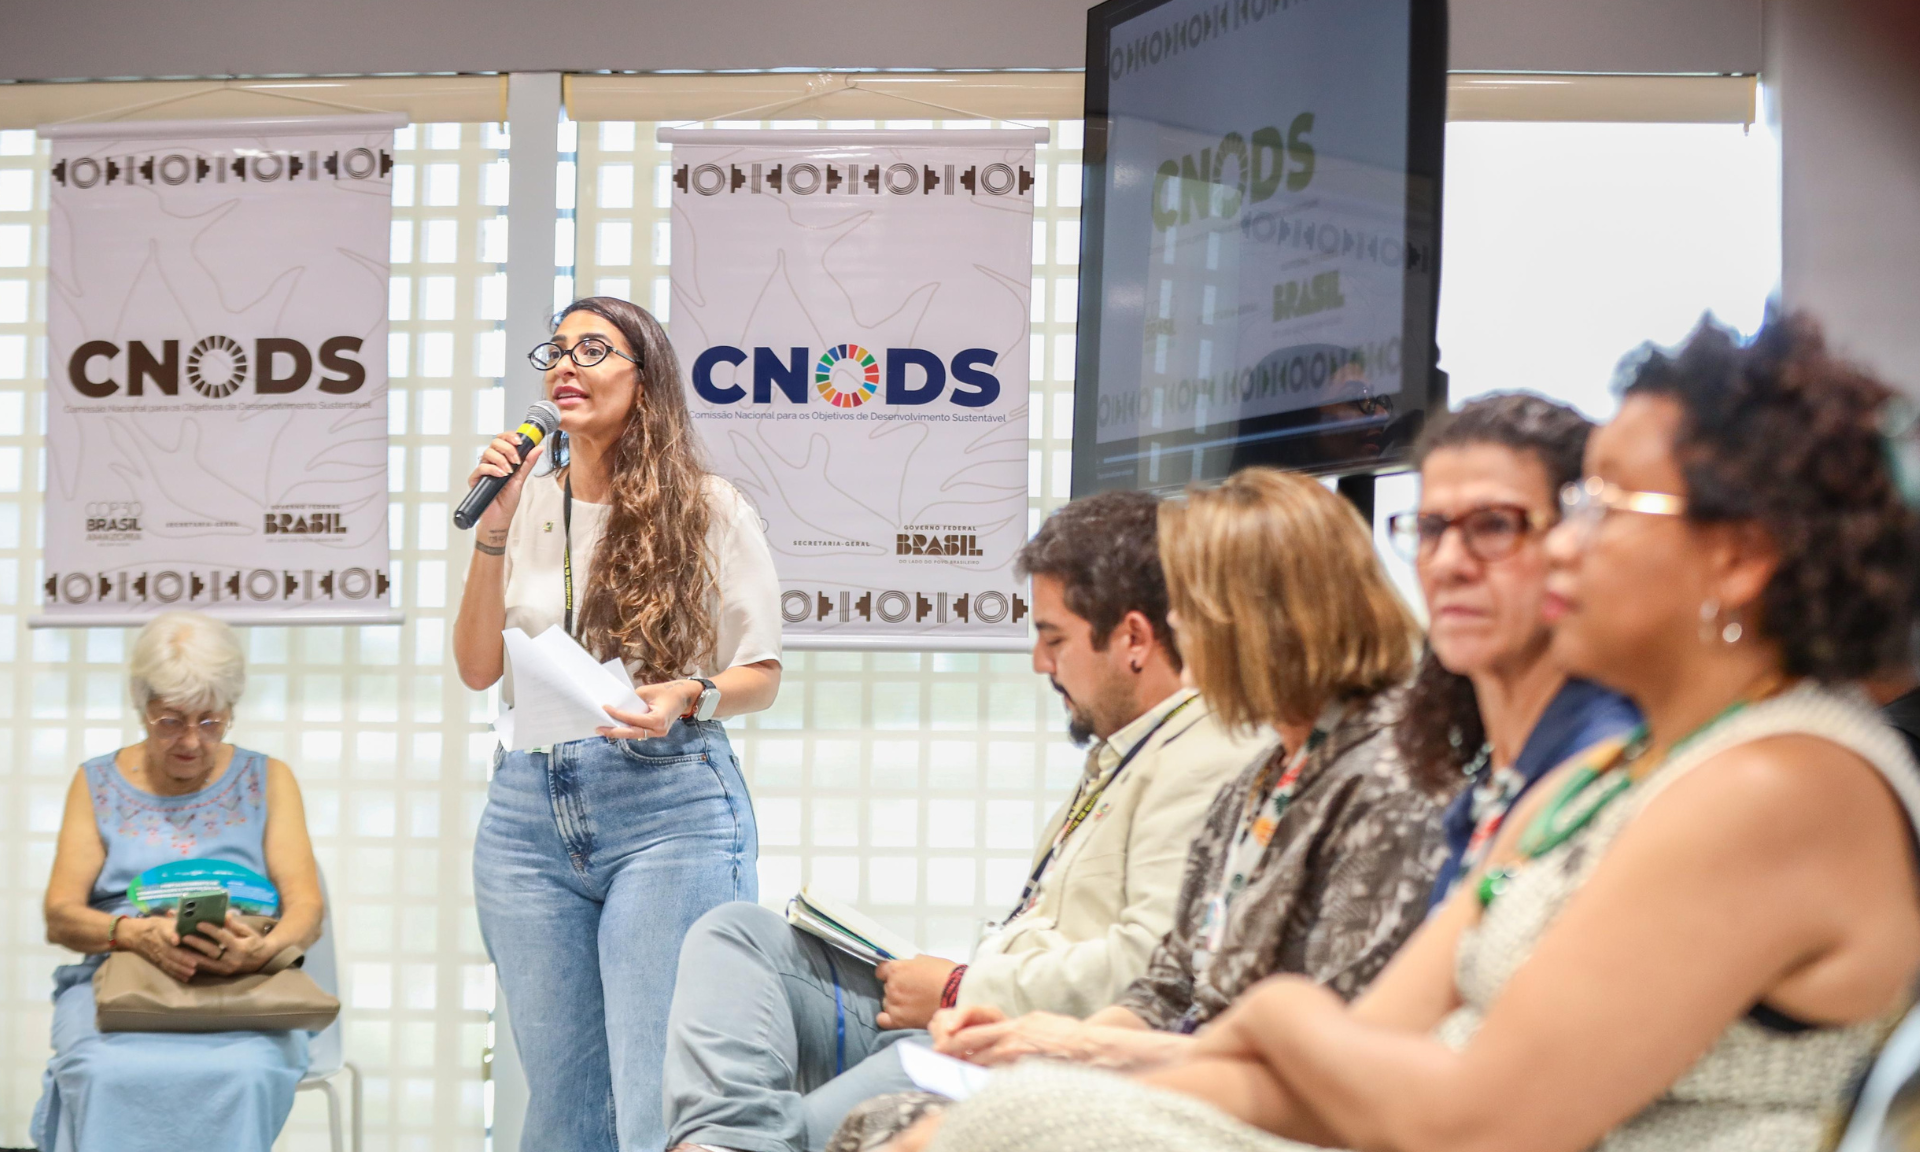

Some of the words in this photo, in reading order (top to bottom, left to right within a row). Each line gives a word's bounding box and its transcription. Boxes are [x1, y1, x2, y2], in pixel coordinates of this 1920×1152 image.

[1152, 112, 1316, 233] CNODS
[67, 334, 367, 399] CNODS
[691, 343, 1001, 408] CNODS
[689, 410, 733, 420] Comissão
[734, 410, 775, 420] Nacional
[776, 412, 798, 423] para
[798, 412, 810, 420] os
[811, 410, 855, 423] Objetivos
[856, 411, 869, 421] de
[870, 411, 950, 422] Desenvolvimento
[952, 412, 1007, 423] Sustentável
[264, 513, 347, 535] BRASIL
[903, 524, 941, 532] GOVERNO
[793, 540, 871, 548] SECRETARIA-GERAL
[896, 533, 984, 557] BRASIL
